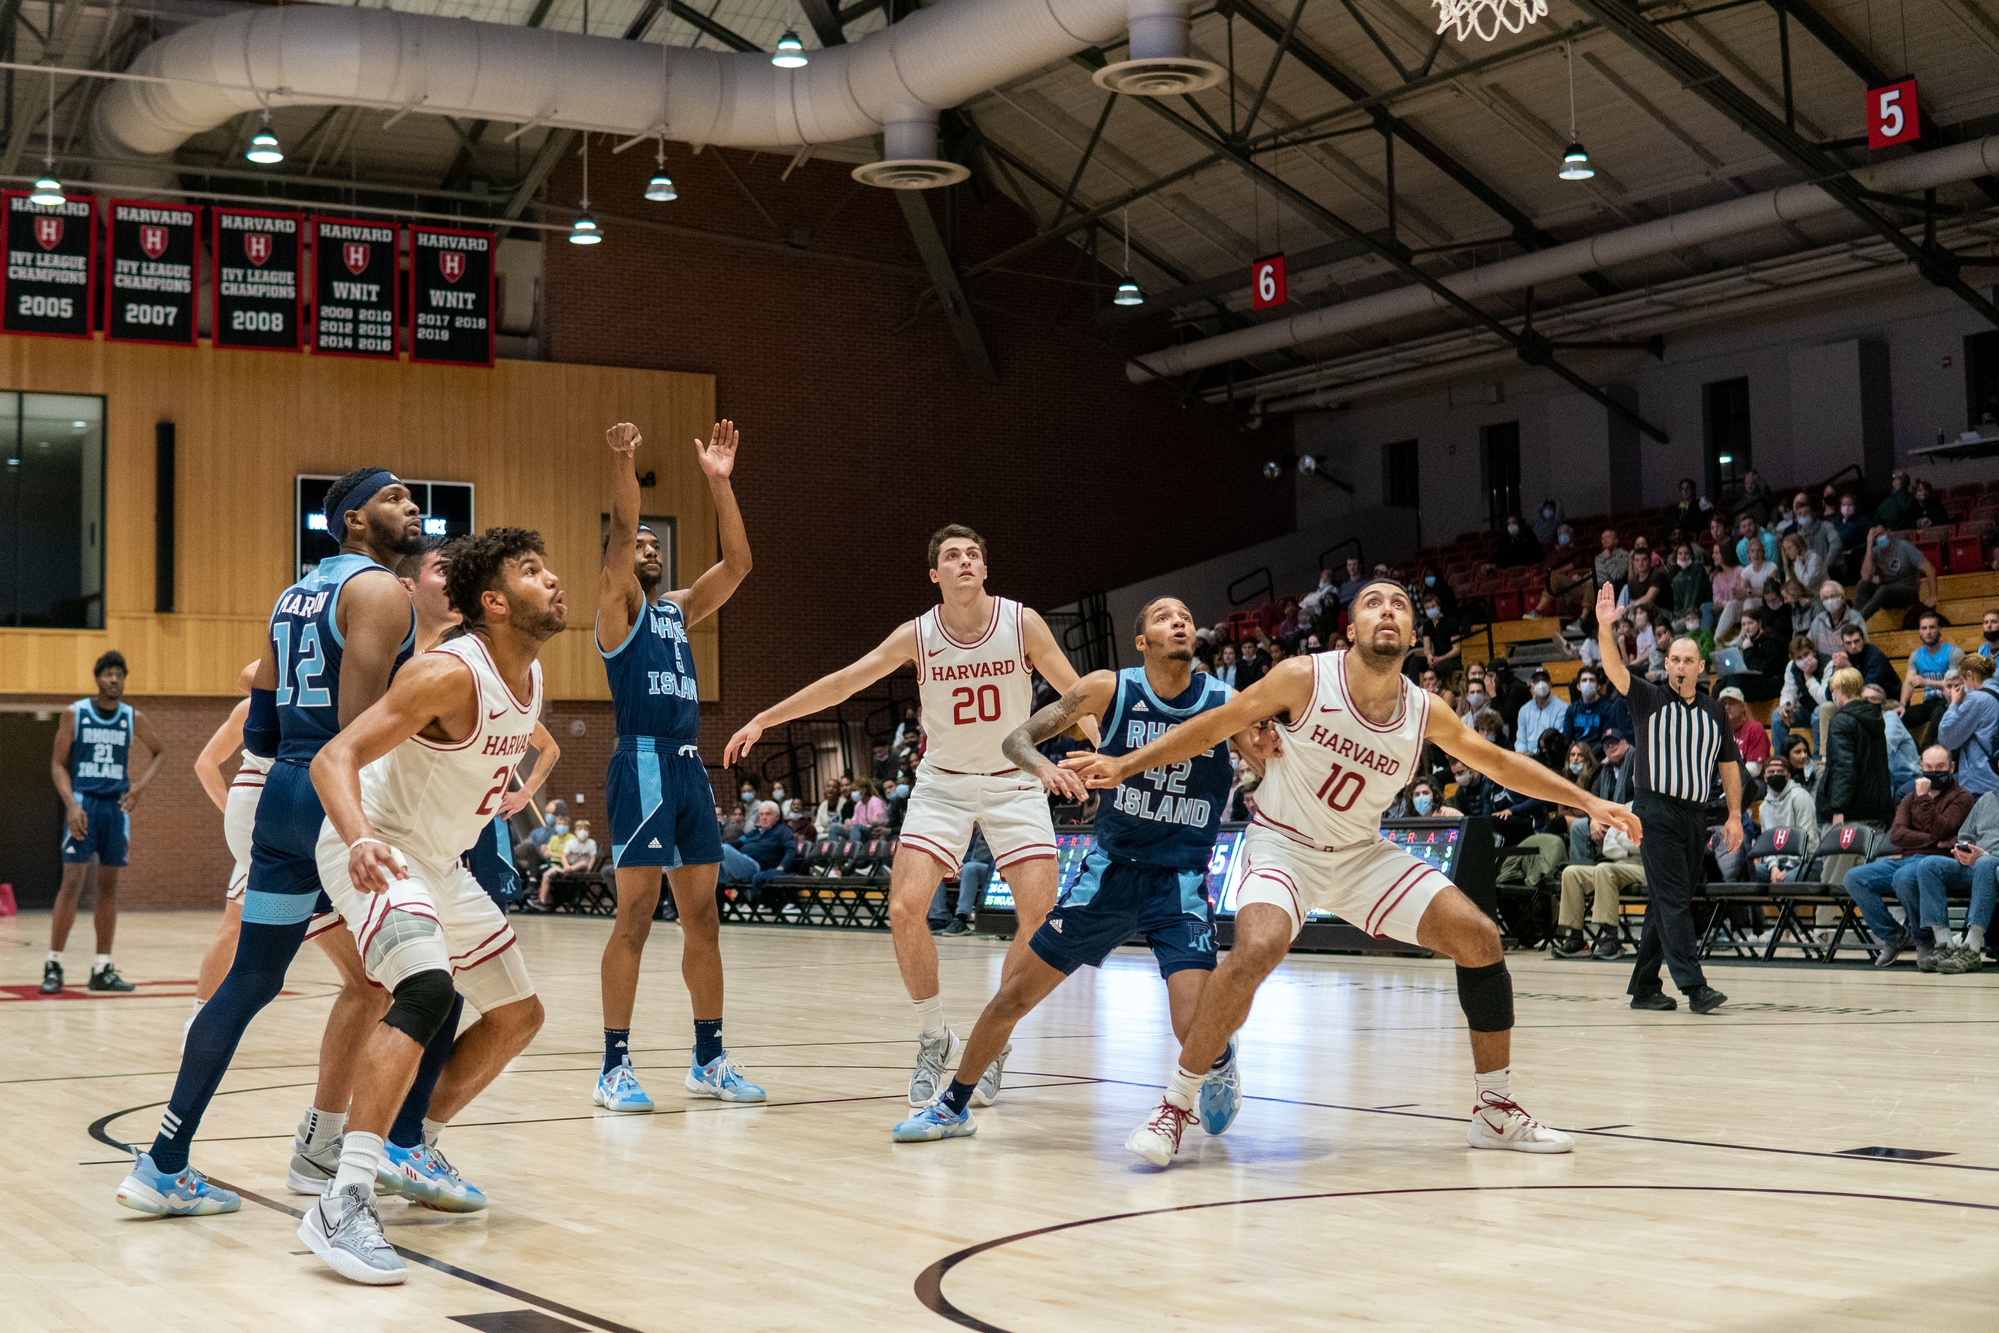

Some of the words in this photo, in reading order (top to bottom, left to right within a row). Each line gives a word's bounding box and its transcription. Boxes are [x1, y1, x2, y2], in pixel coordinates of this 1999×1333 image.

[1880, 89, 1904, 138] 5
[11, 197, 90, 217] HARVARD
[116, 206, 194, 226] HARVARD
[42, 220, 56, 241] H
[221, 214, 297, 233] HARVARD
[319, 223, 393, 243] HARVARD
[146, 229, 161, 249] H
[251, 237, 265, 257] H
[417, 233, 489, 252] HARVARD
[10, 250, 34, 266] IVY
[36, 253, 87, 270] LEAGUE
[350, 246, 364, 266] H
[445, 255, 459, 275] H
[8, 266, 87, 285] CHAMPIONS
[116, 259, 139, 275] IVY
[141, 261, 191, 279] LEAGUE
[222, 267, 244, 282] IVY
[246, 269, 296, 285] LEAGUE
[115, 274, 192, 294] CHAMPIONS
[221, 282, 296, 299] CHAMPIONS
[332, 281, 380, 302] WNIT
[1259, 264, 1276, 302] 6
[19, 294, 74, 318] 2005
[429, 289, 476, 310] WNIT
[126, 303, 178, 326] 2007
[232, 310, 284, 332] 2008
[358, 308, 392, 323] 2010
[417, 312, 450, 327] 2017
[320, 320, 353, 335] 2012
[319, 334, 353, 349] 2014
[273, 621, 332, 707] 12
[931, 659, 1015, 681] HARVARD
[952, 684, 1001, 726] 20
[82, 727, 126, 746] RHODE
[93, 743, 114, 764] 21
[1310, 724, 1400, 776] HARVARD
[1143, 758, 1193, 794] 42
[1316, 762, 1366, 812] 10
[1113, 782, 1211, 828] ISLAND
[1071, 837, 1077, 847] R
[1083, 837, 1090, 847] A
[1408, 832, 1415, 843] R
[1427, 832, 1434, 843] A
[1449, 831, 1457, 842] F
[1776, 829, 1786, 845] H
[1842, 828, 1853, 844] H
